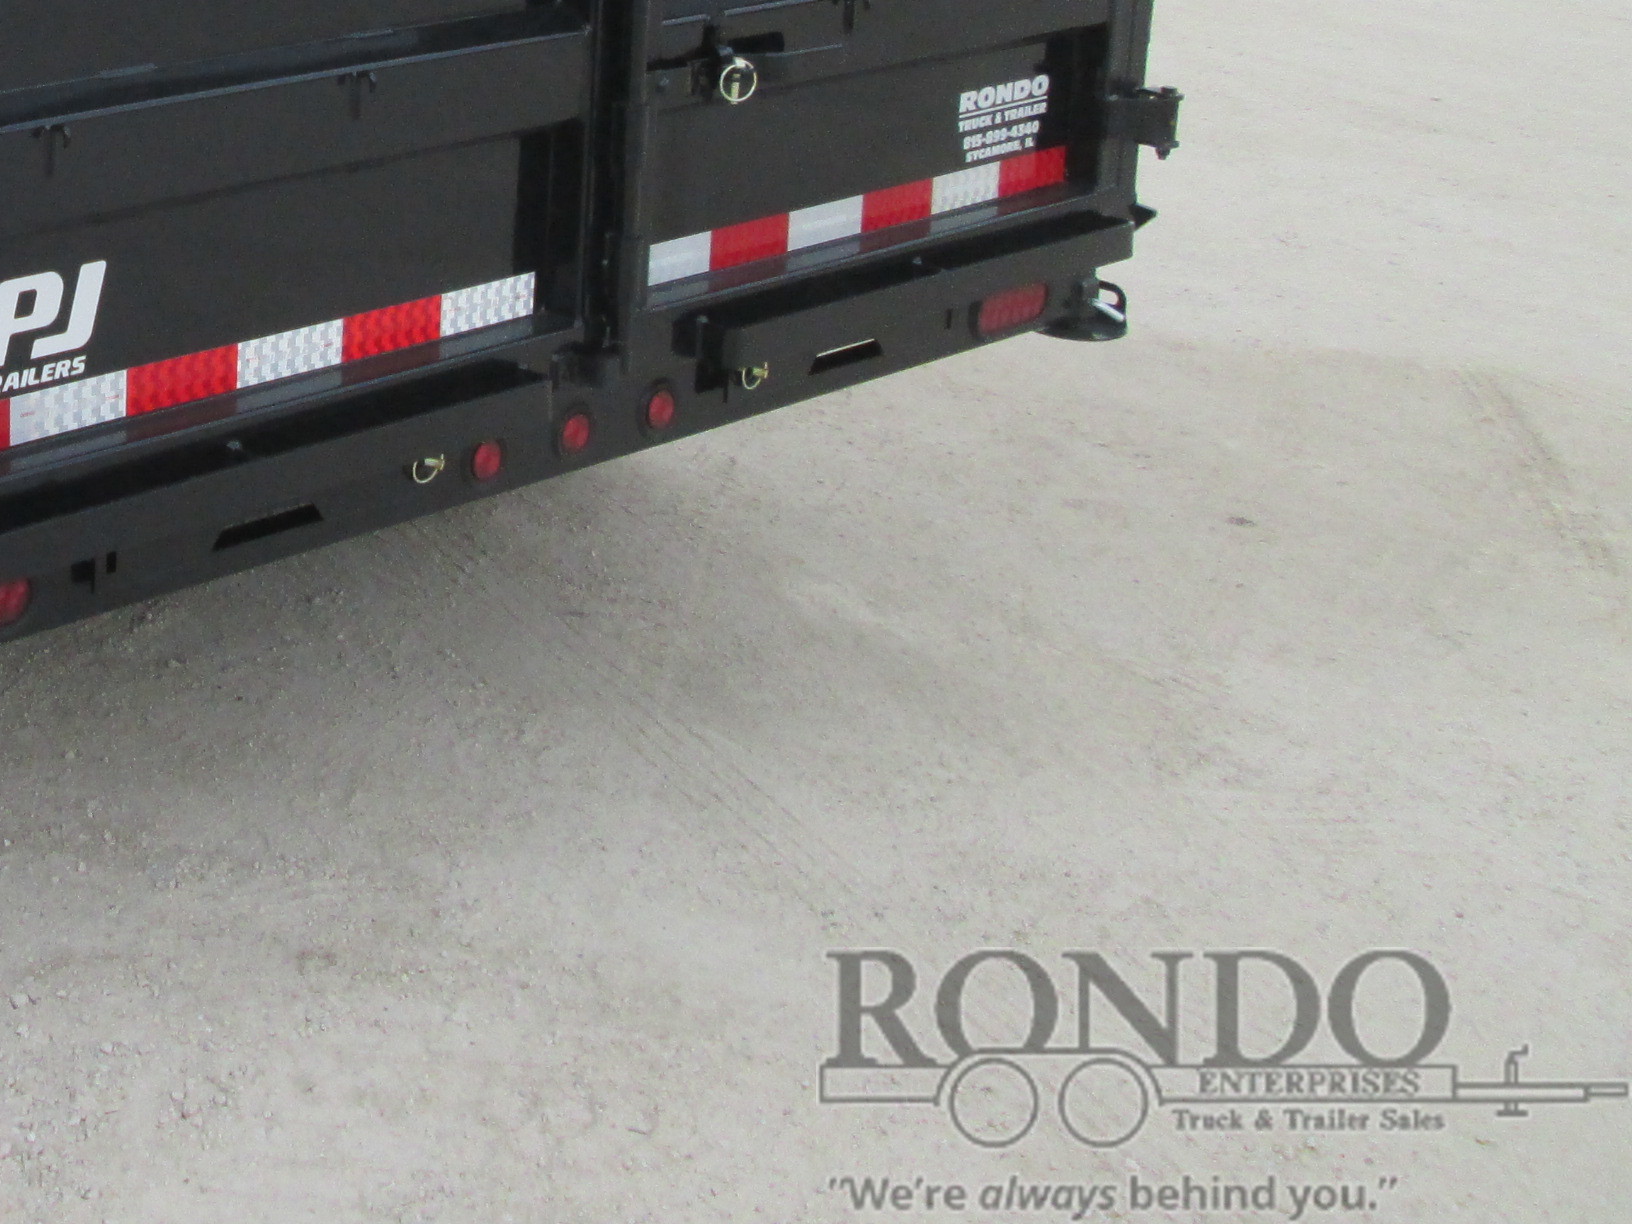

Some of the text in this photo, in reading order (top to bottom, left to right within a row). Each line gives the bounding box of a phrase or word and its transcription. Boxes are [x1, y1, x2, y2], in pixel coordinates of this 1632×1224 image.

[959, 75, 1050, 113] RONDO
[958, 114, 994, 133] TRUCK
[1004, 102, 1048, 122] TRAILER
